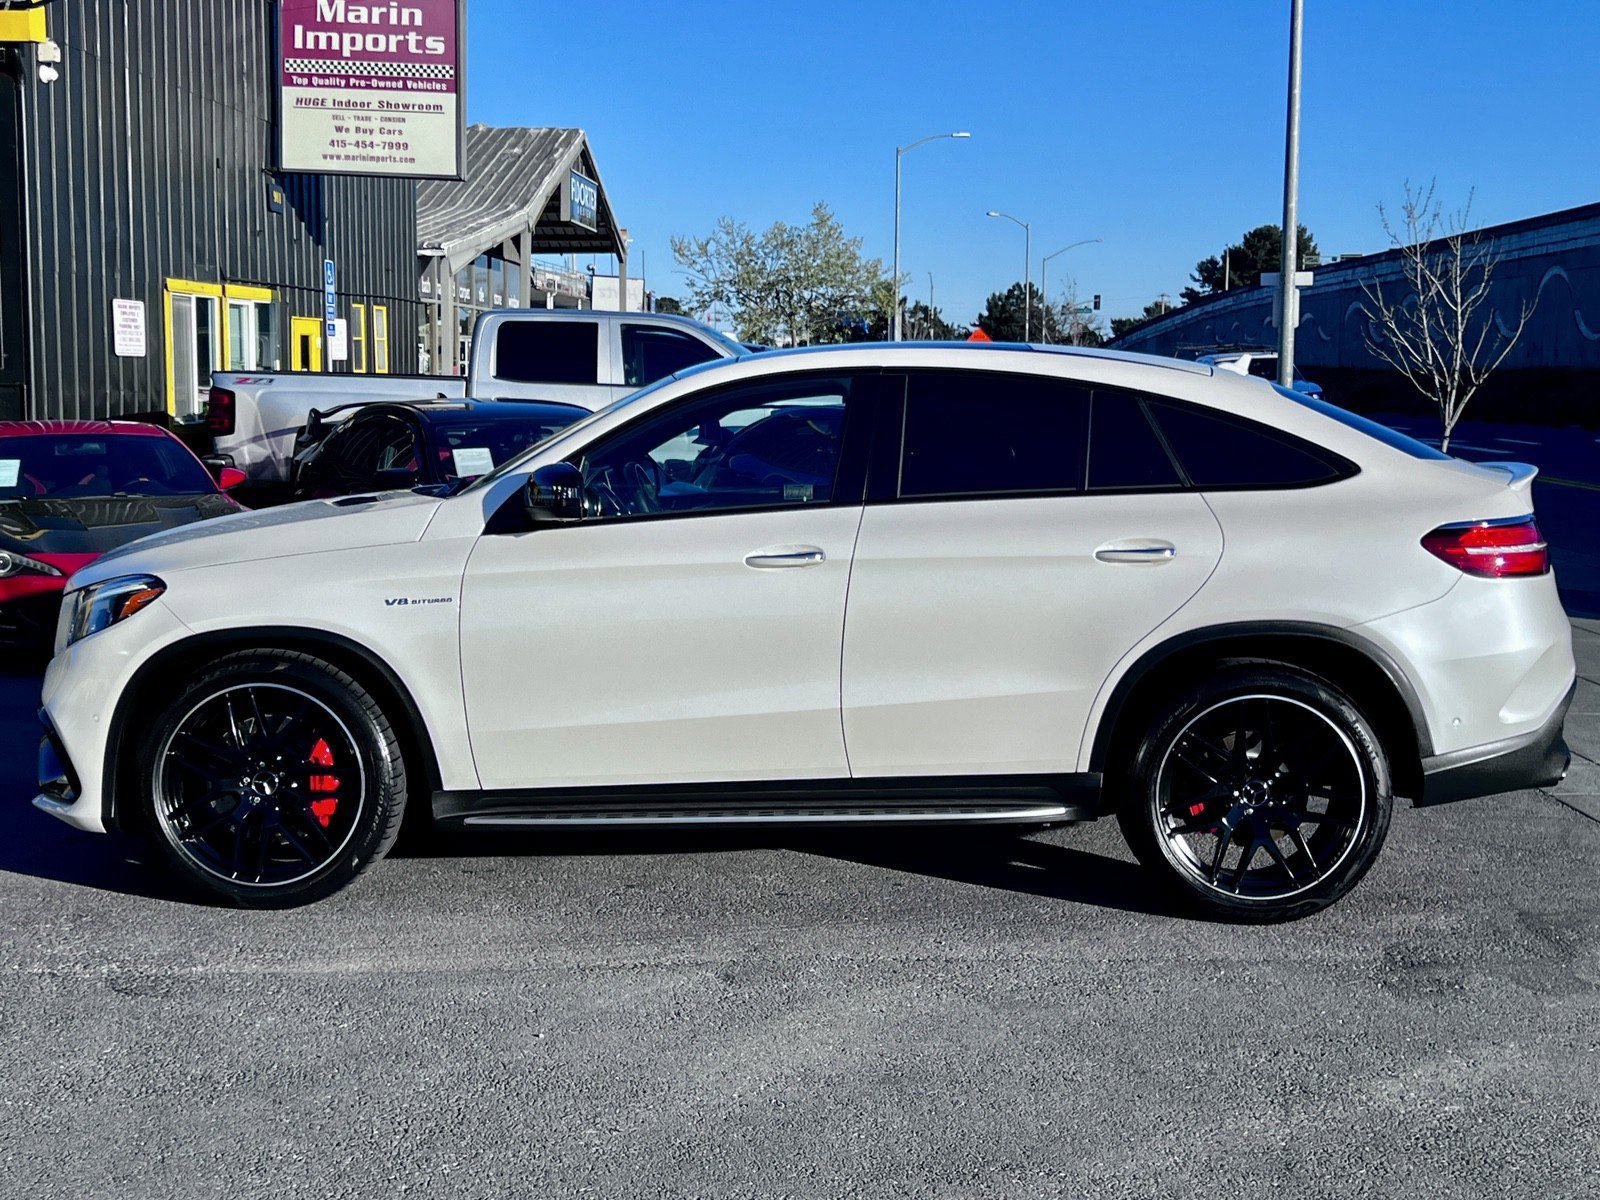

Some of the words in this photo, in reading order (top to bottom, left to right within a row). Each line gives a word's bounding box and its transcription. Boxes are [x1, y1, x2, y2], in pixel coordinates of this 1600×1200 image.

[316, 0, 423, 26] Marin
[293, 24, 446, 57] Imports
[291, 75, 309, 86] Top
[311, 76, 346, 88] Quality
[349, 77, 403, 89] Pre-Owned
[406, 79, 447, 91] Vehicles
[295, 97, 327, 107] HUGE
[332, 98, 372, 109] Indoor
[377, 100, 443, 112] Showroom
[334, 125, 350, 134] We
[354, 126, 374, 136] Buy
[379, 127, 404, 136] Cars
[328, 139, 409, 151] 415-454-7999
[321, 153, 416, 165] www.marinimports.com
[384, 597, 409, 606] V8
[411, 597, 453, 605] BITURBO
